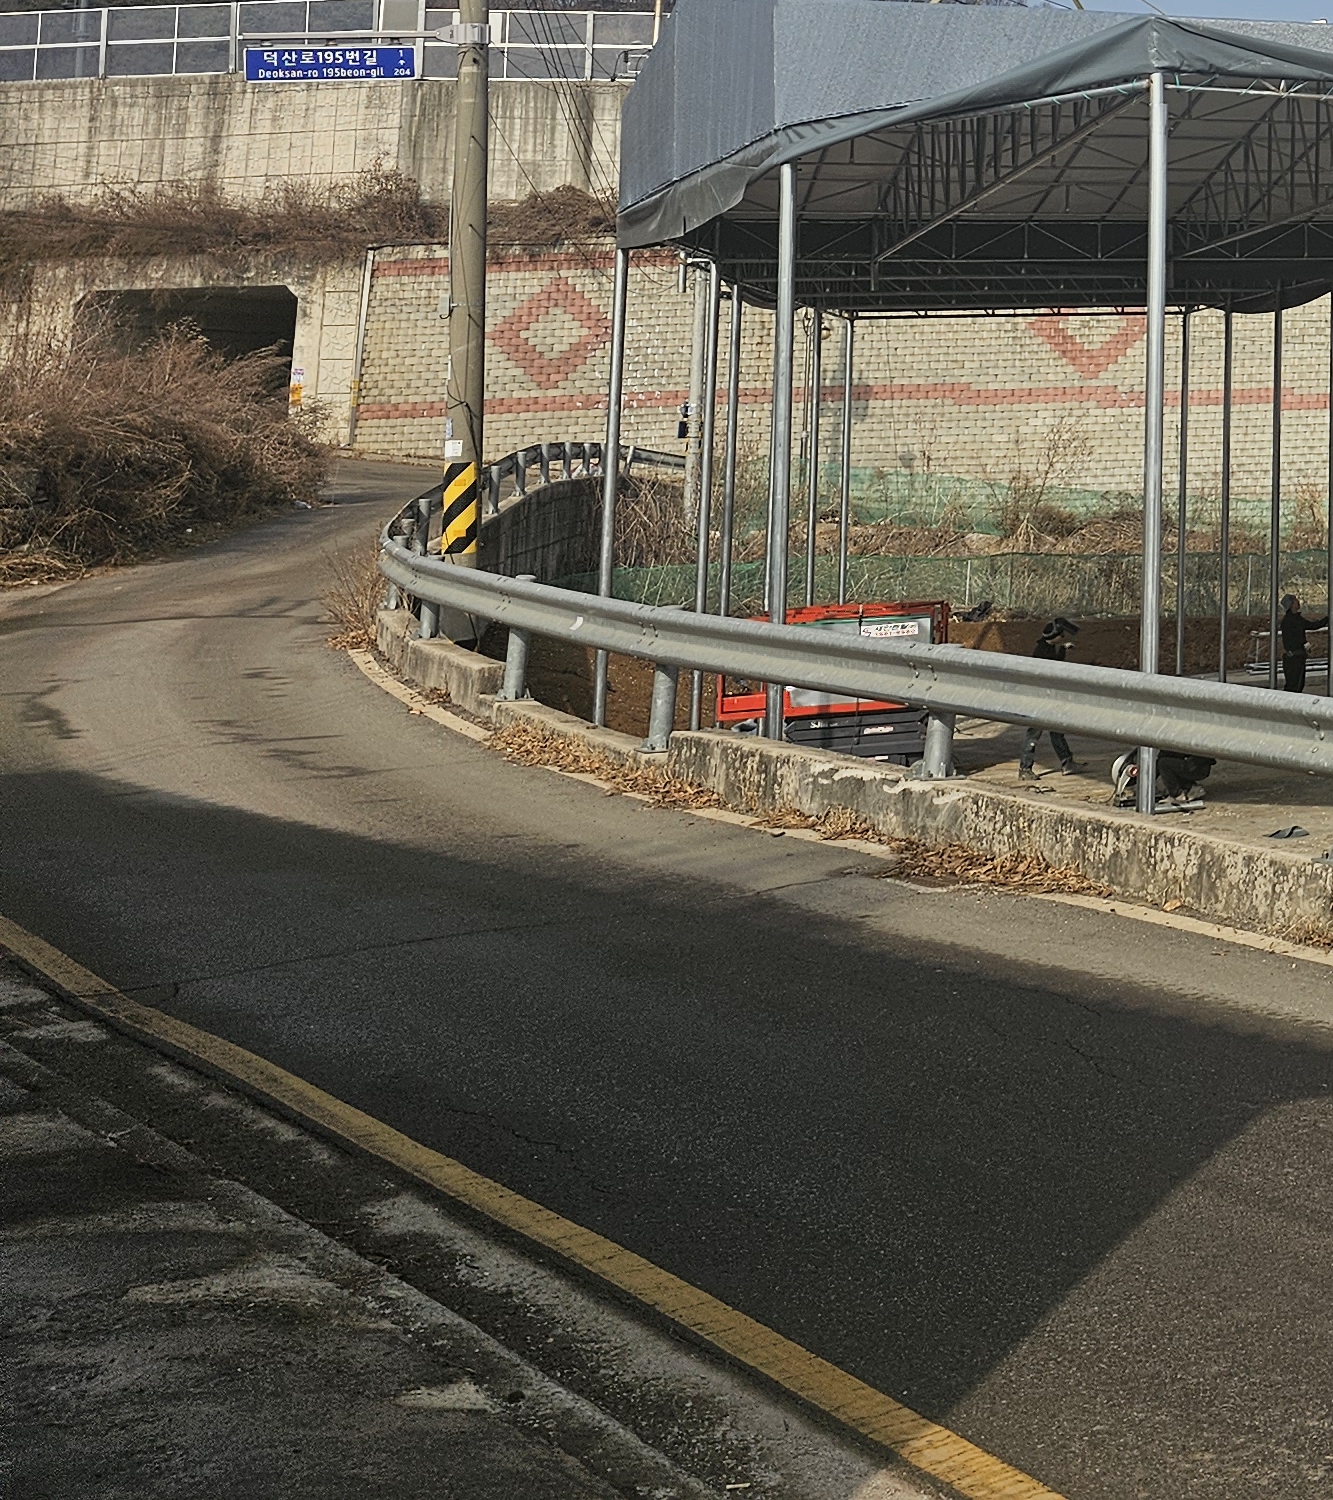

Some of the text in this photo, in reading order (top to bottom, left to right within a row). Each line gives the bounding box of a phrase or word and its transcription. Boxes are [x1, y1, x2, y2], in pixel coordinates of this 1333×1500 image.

[263, 50, 377, 66] 덕산로195번길
[258, 67, 385, 79] Deoksan-ro 195beon-gil
[394, 68, 411, 76] 204
